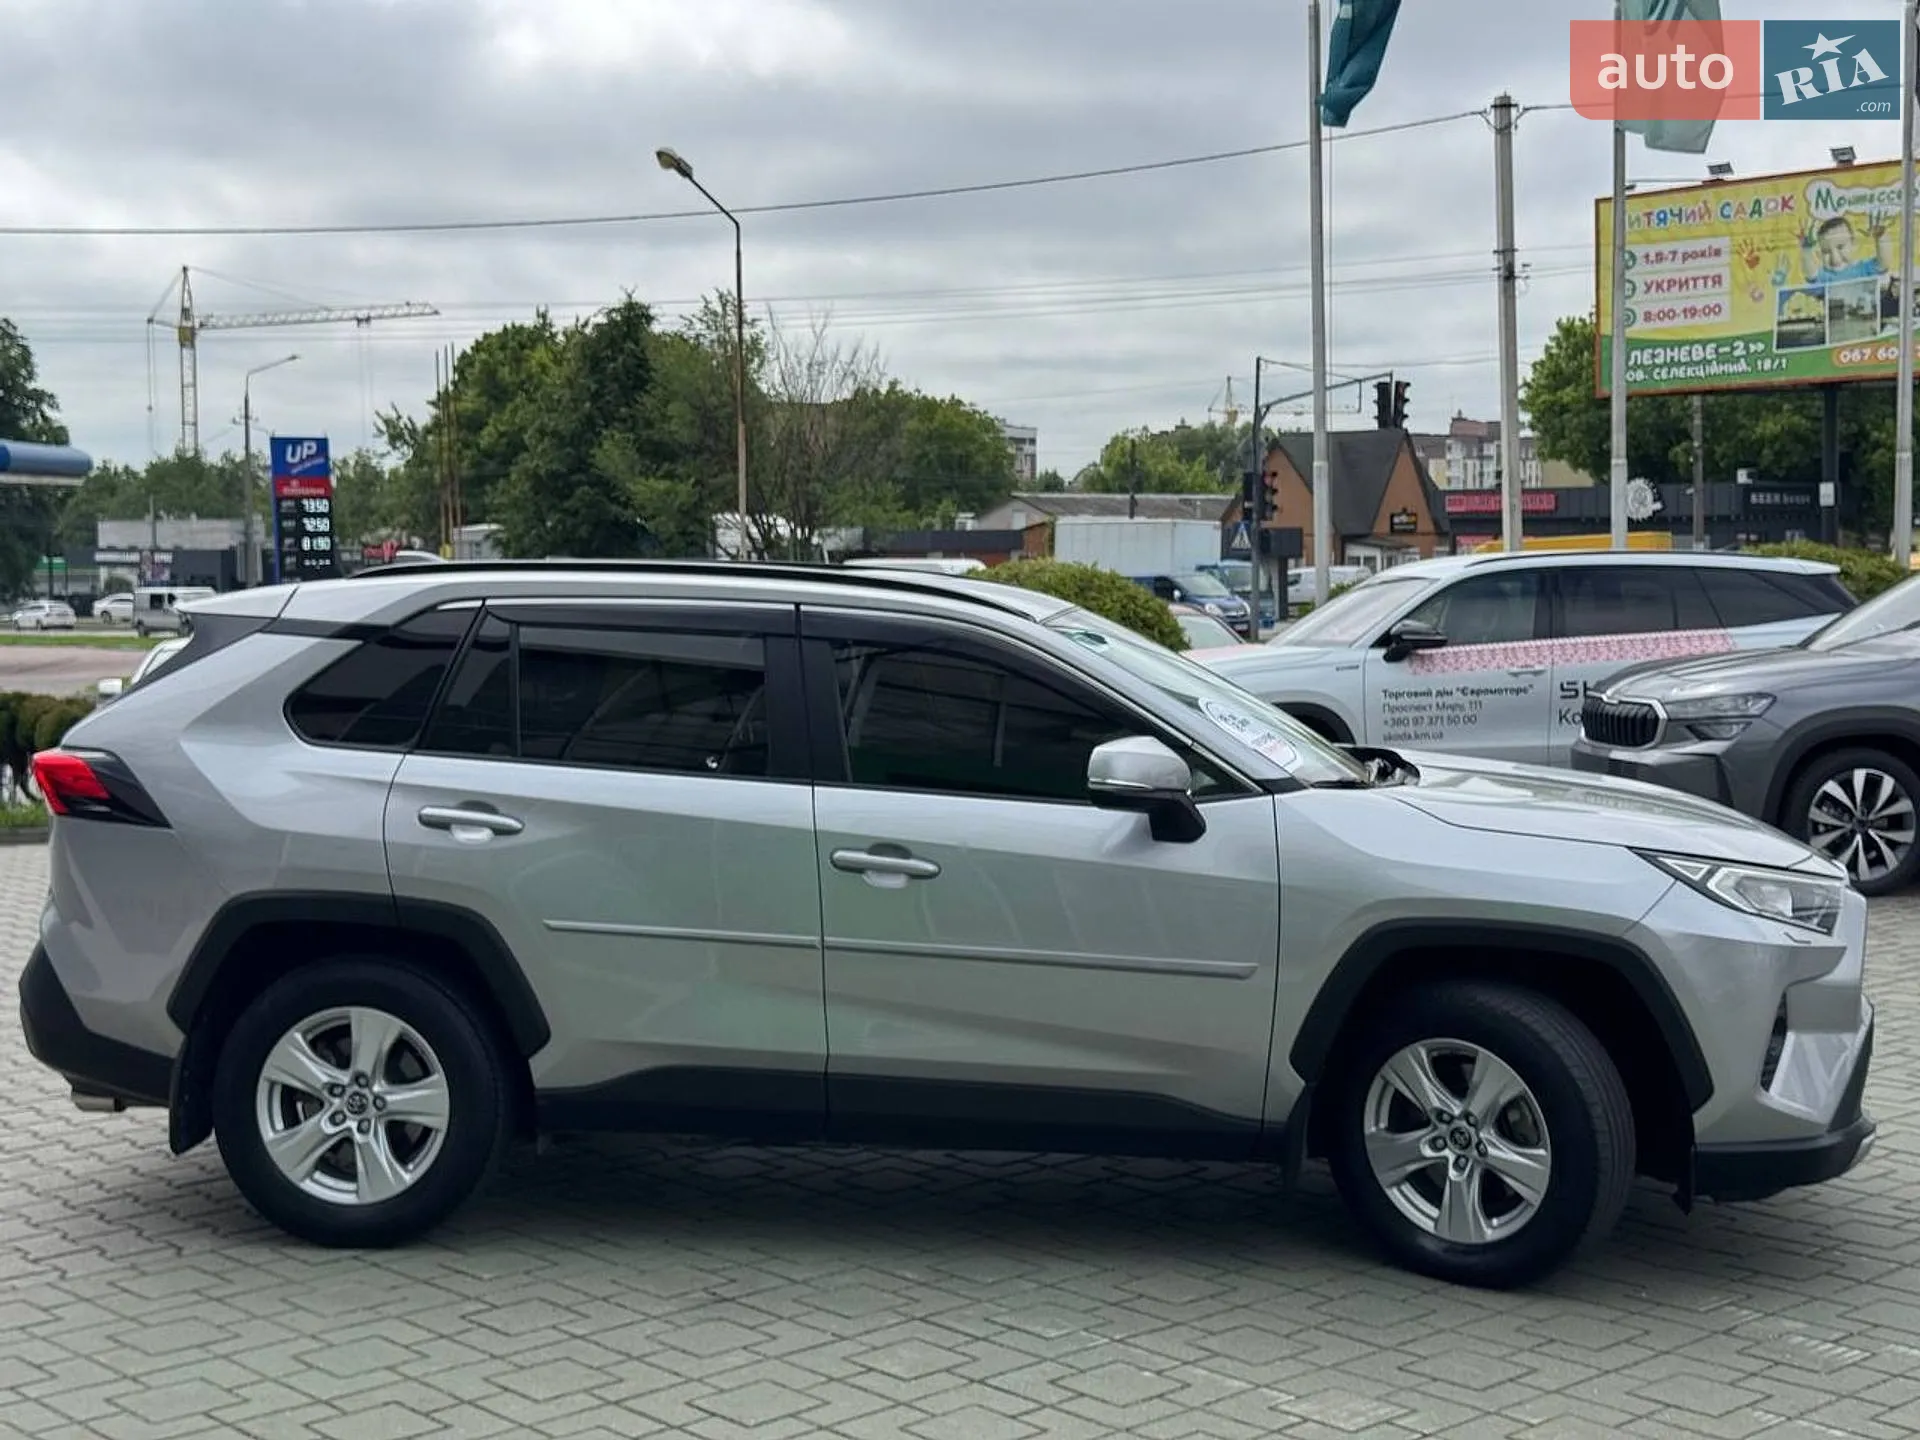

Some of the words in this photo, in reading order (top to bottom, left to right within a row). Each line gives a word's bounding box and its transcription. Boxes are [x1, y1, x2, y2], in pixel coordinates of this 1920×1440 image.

[1627, 199, 1713, 229] ИТЯЧИЙ
[1719, 195, 1795, 220] САДОК
[1643, 273, 1723, 295] УКРИТТЯ
[1877, 345, 1899, 361] 60
[1625, 369, 1649, 382] ОВ.
[286, 441, 317, 464] UP
[1382, 687, 1433, 701] Торговий
[1558, 707, 1583, 726] Ko
